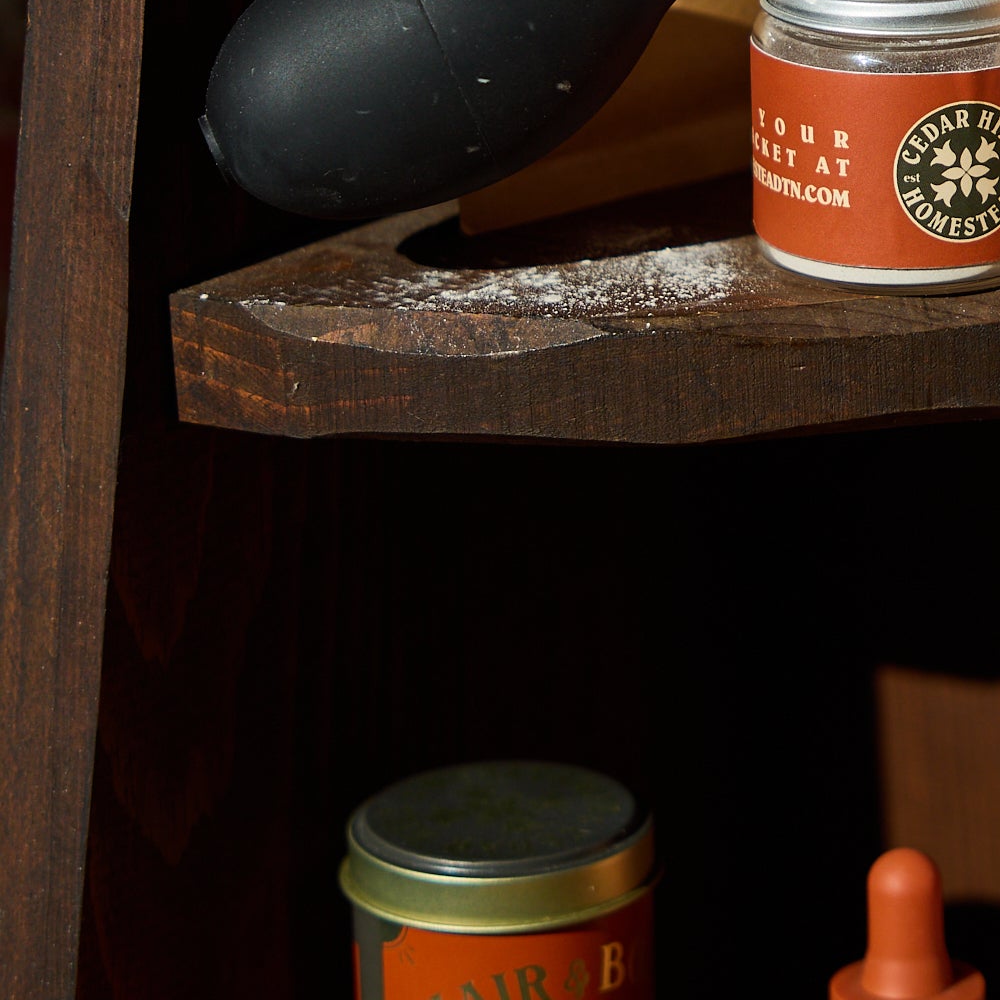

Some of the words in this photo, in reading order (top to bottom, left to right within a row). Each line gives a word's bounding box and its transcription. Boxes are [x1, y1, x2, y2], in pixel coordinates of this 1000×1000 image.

[758, 107, 849, 149] YOUR
[901, 109, 970, 165] CEDAR
[752, 156, 851, 208] STEADTN.COM
[815, 156, 850, 177] AT
[903, 173, 921, 183] est
